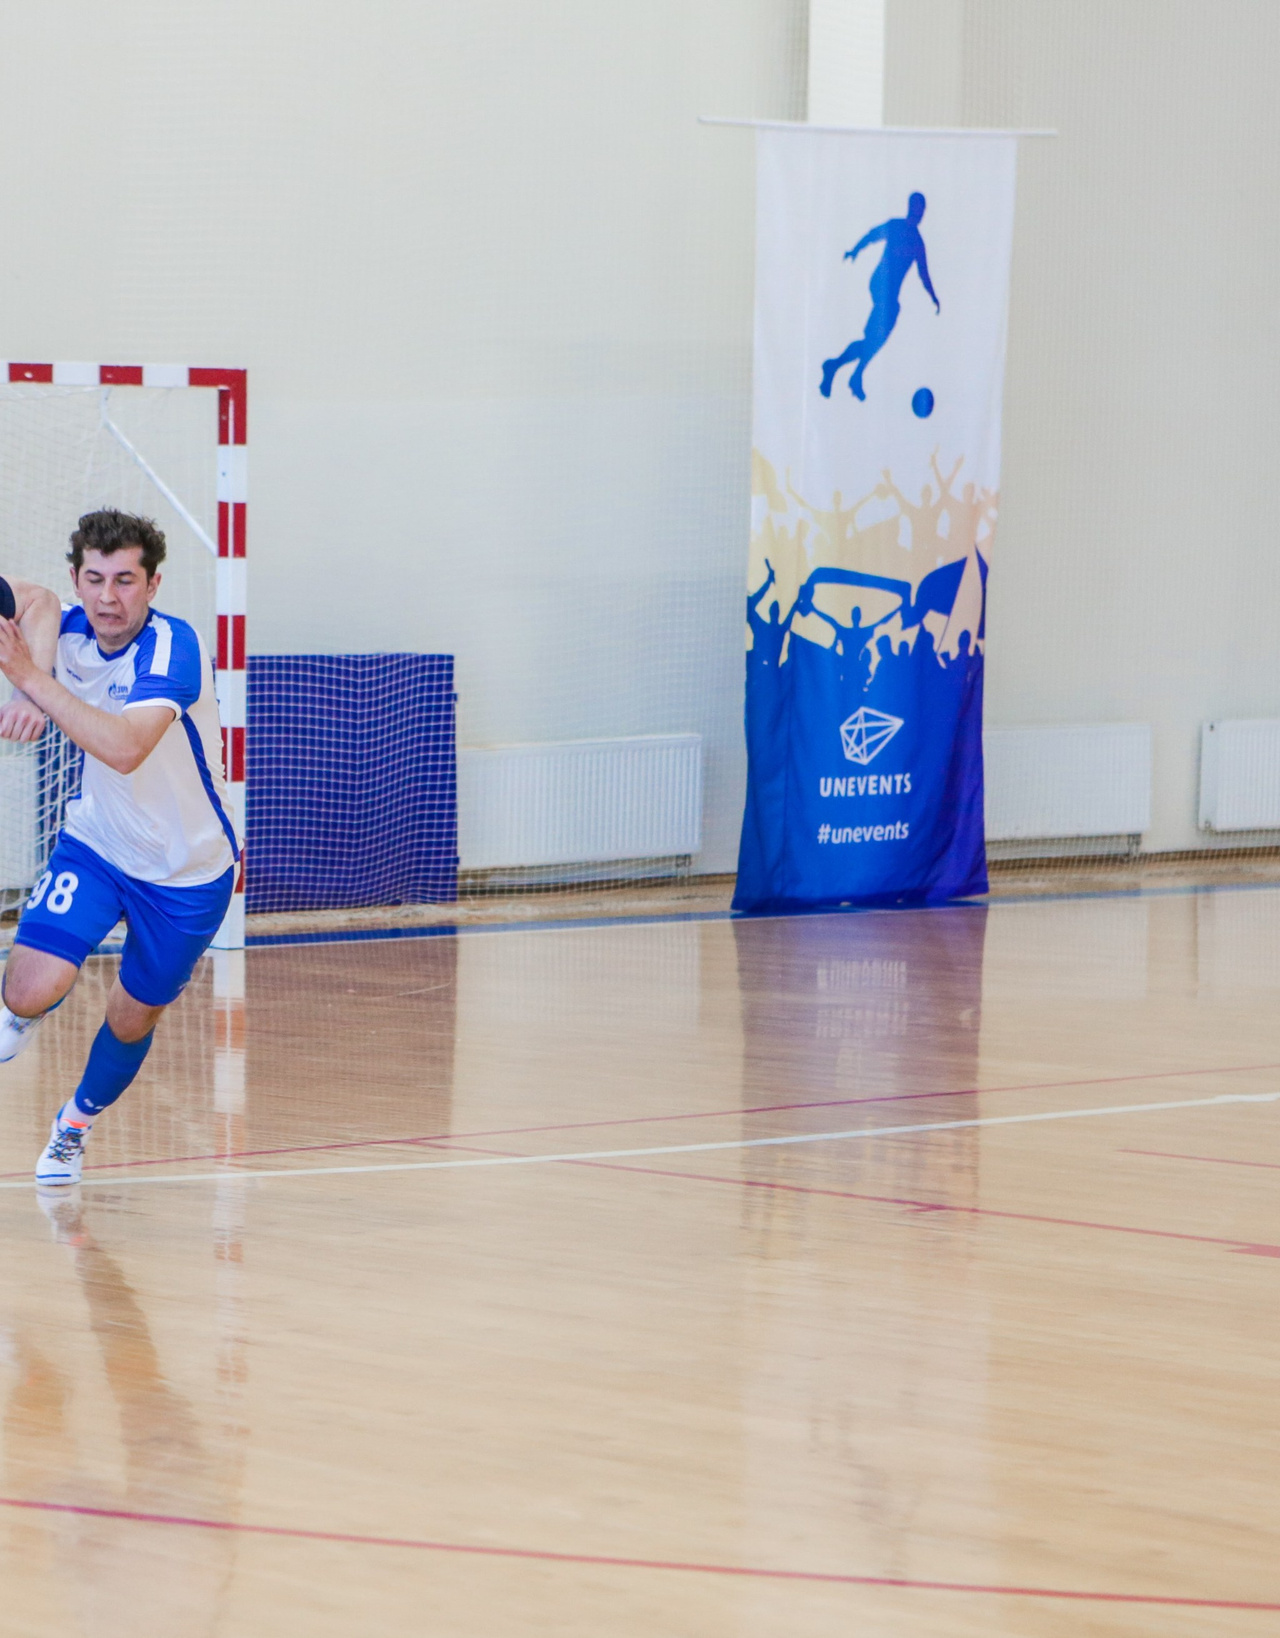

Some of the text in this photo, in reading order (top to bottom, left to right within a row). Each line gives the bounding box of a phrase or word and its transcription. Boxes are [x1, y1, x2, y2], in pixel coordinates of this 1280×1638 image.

[819, 773, 912, 797] UNEVENTS
[817, 820, 909, 844] #unevents
[26, 870, 79, 915] 98
